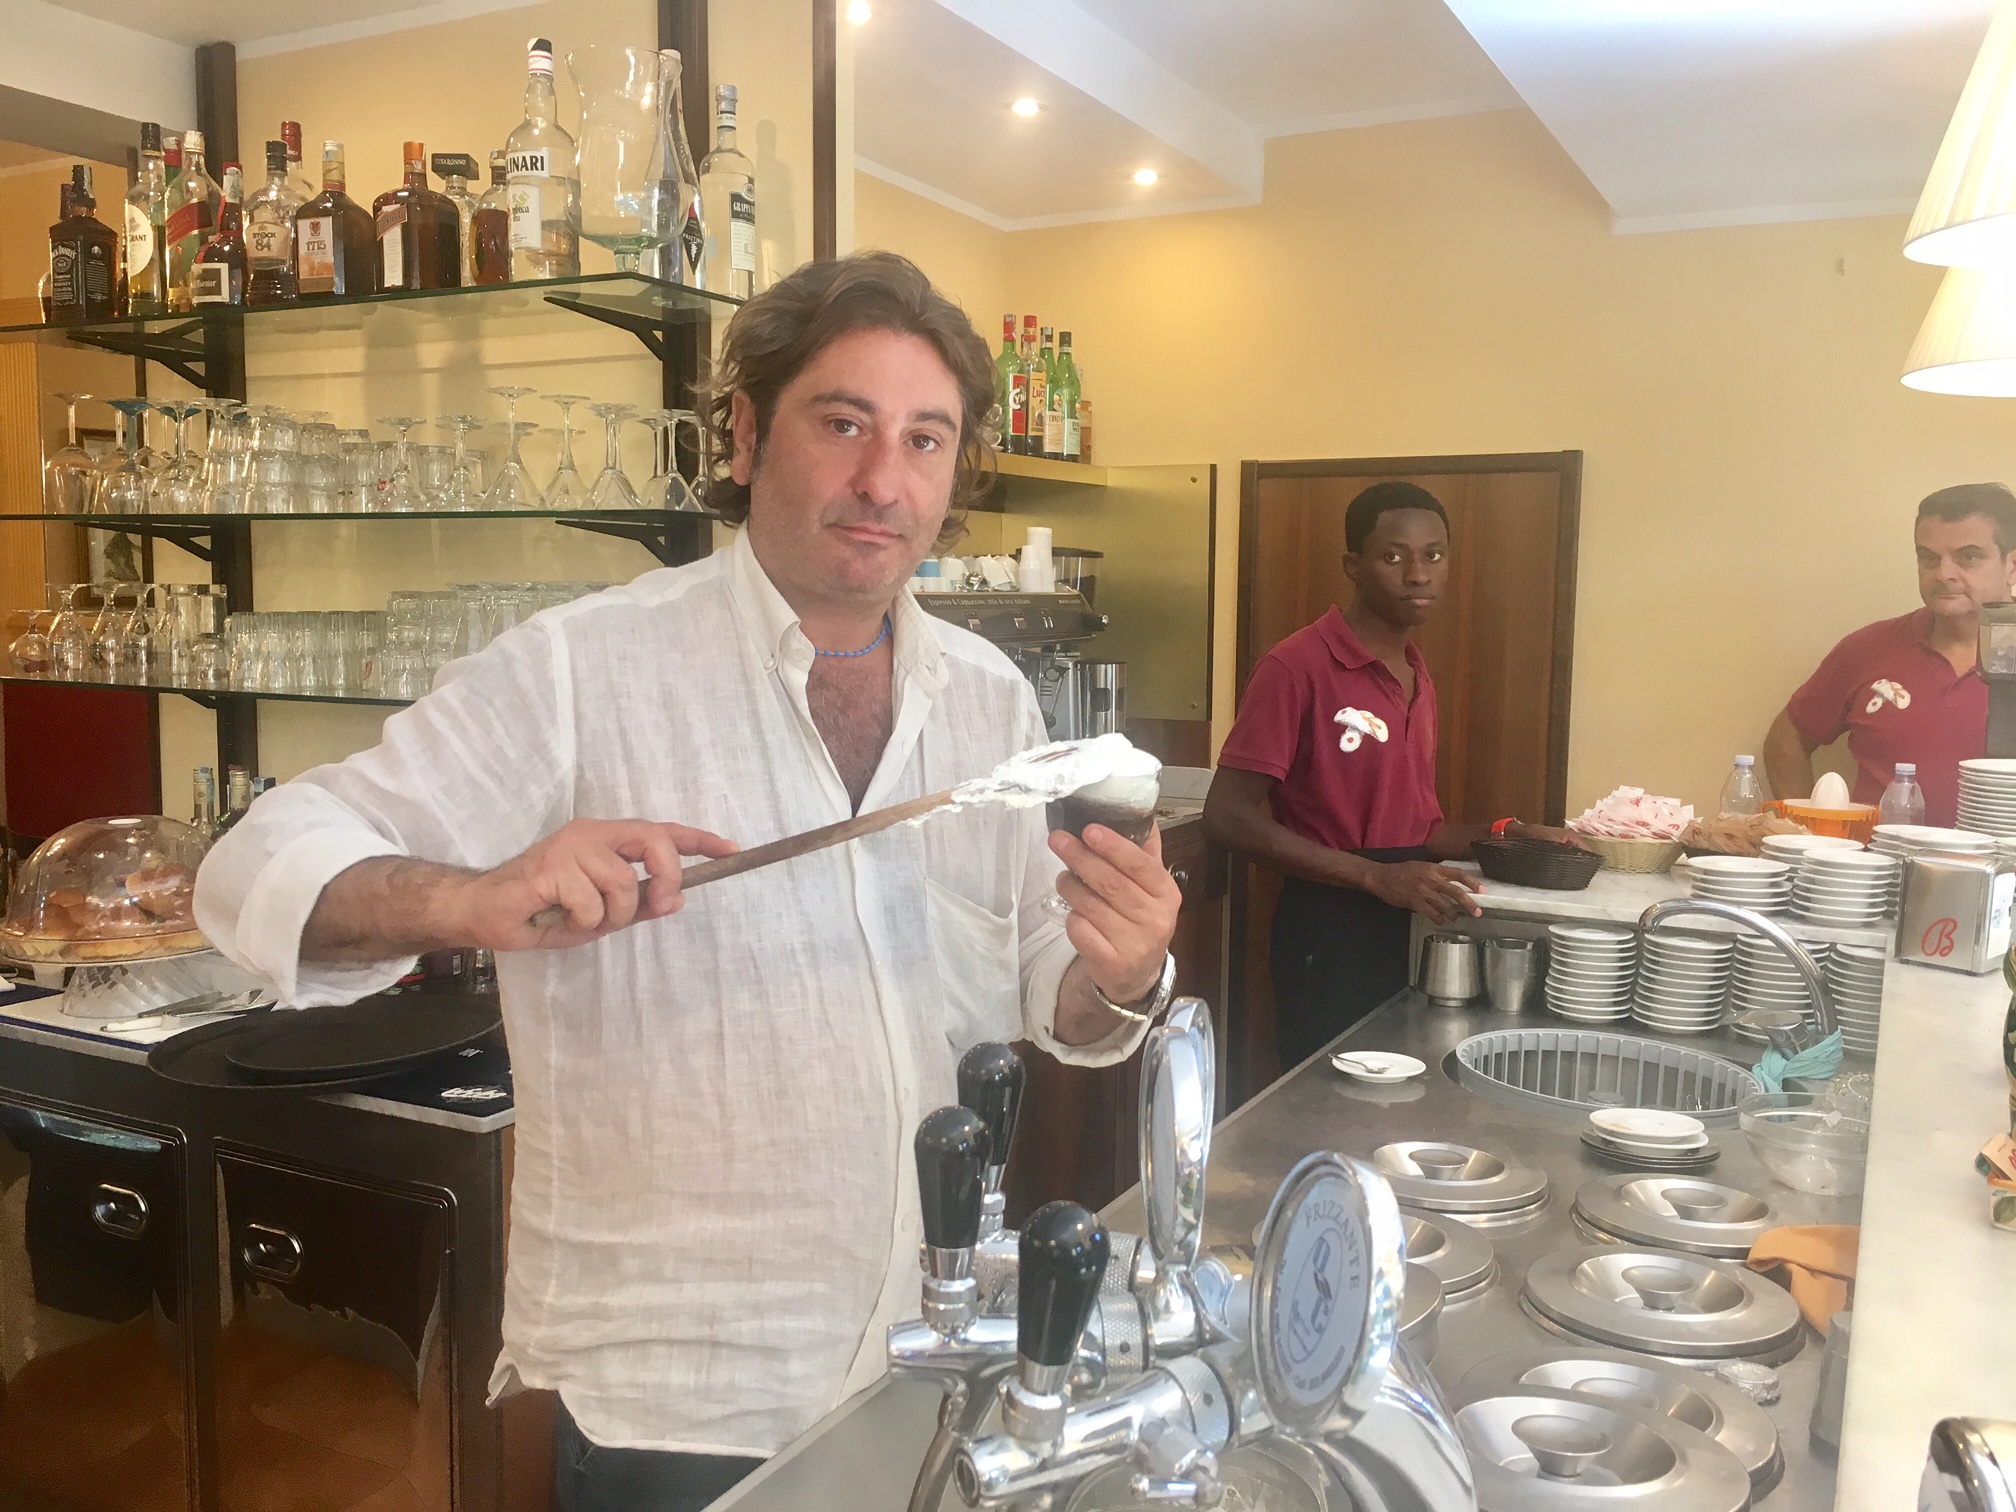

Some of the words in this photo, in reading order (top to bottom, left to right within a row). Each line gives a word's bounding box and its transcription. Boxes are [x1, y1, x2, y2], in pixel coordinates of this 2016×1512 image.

[506, 155, 545, 174] LINARI
[252, 231, 277, 240] STOCK
[255, 239, 272, 251] 84
[305, 240, 327, 252] 1715
[1305, 1199, 1361, 1291] FRIZZANTE
